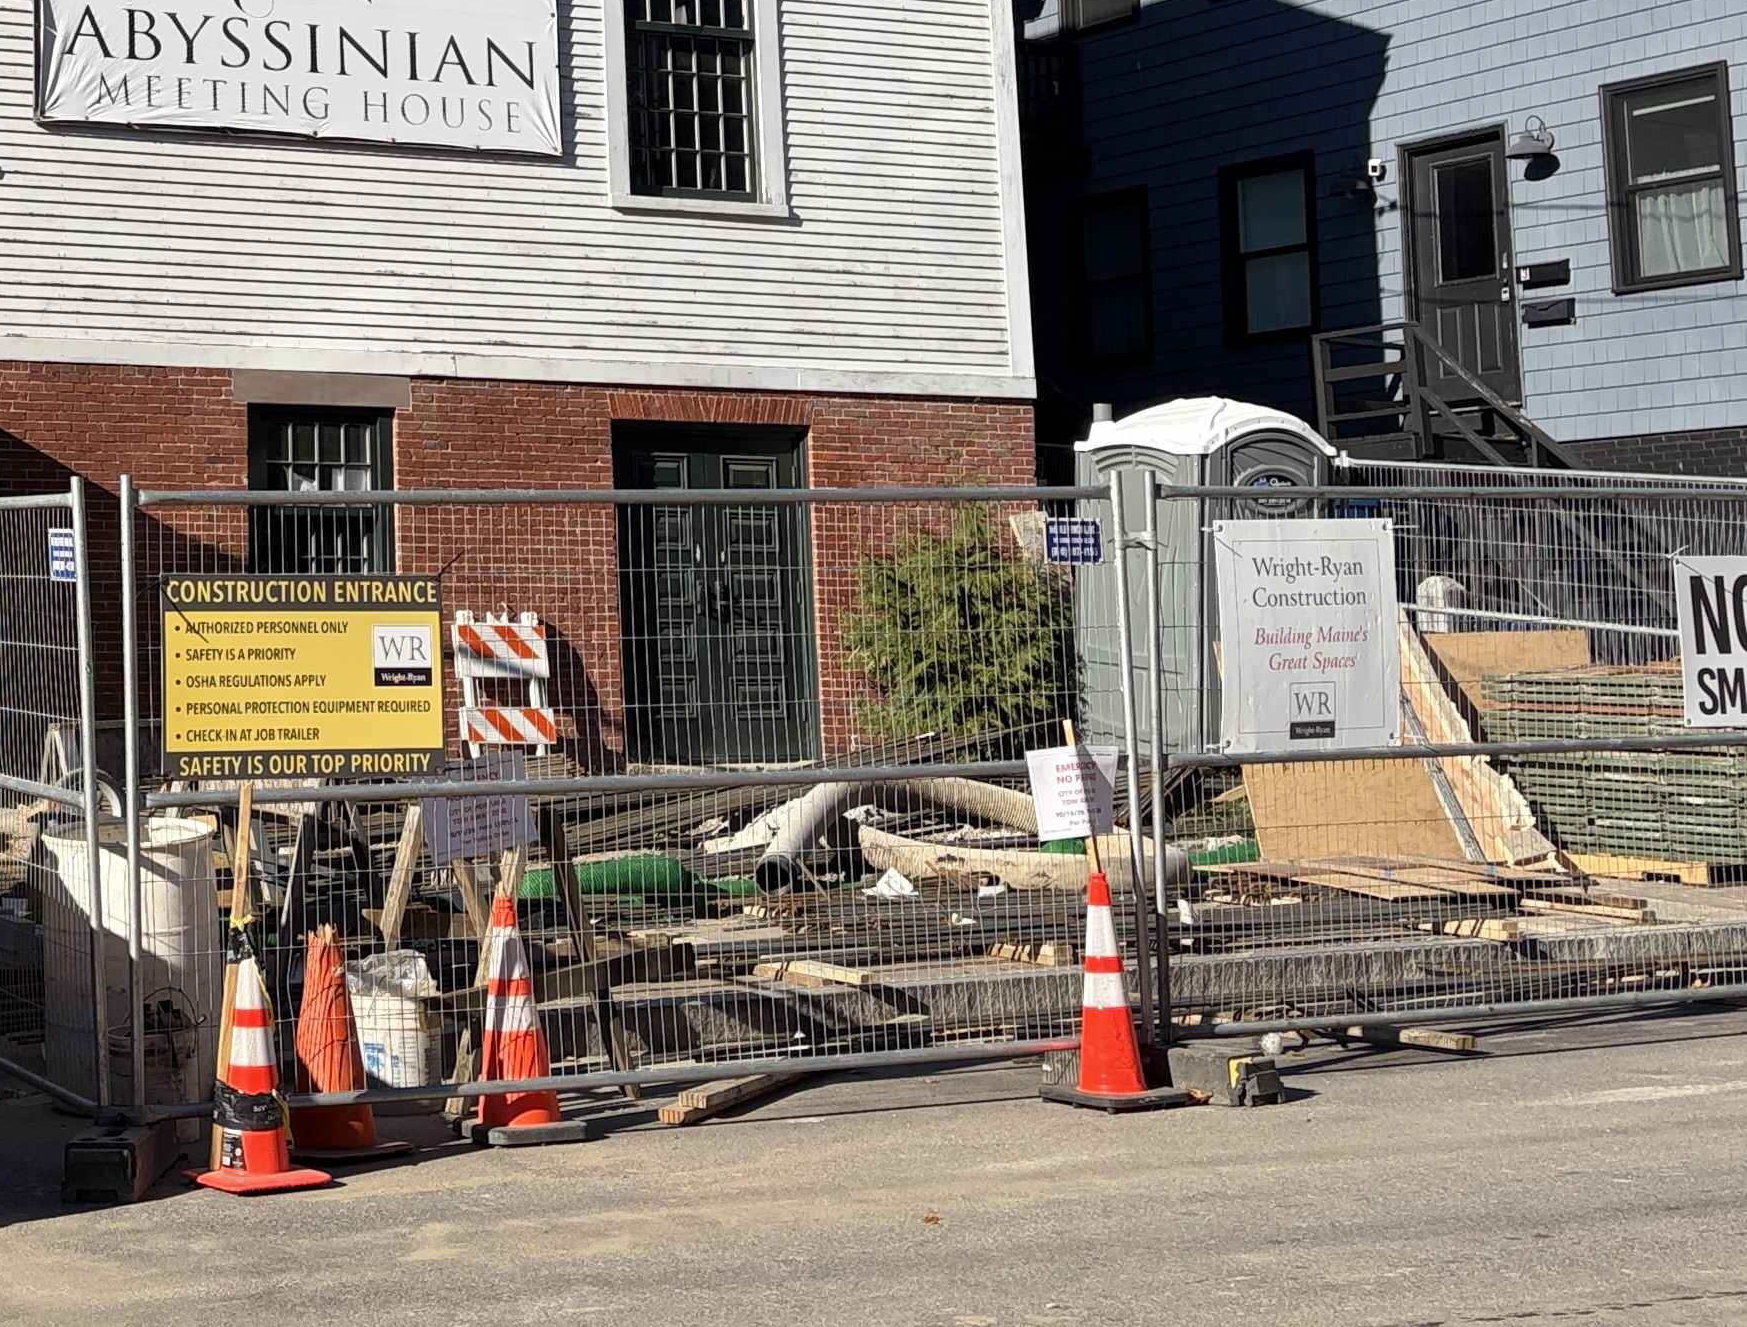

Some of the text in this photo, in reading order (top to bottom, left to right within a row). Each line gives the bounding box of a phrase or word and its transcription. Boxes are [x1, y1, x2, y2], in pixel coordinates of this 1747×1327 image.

[64, 4, 537, 90] ABYSSINIAN
[97, 72, 521, 134] MEETING HOUSE
[1252, 556, 1364, 584] Wright-Ryan
[167, 580, 437, 603] CONSTRUCTION ENTRANCE
[1252, 586, 1367, 608] Construction
[185, 621, 348, 634] AUTHORIZED PERSONNEL ONLY
[1254, 624, 1368, 649] Building Maine's
[186, 648, 296, 661] SAFETY IS A PRIORITY
[379, 635, 427, 662] WR
[1269, 651, 1358, 673] Great Spaces
[186, 674, 326, 688] OSHA REGULATIONS APPLY
[381, 673, 427, 684] Wright-Ryan
[186, 700, 431, 715] PERSONAL PROTECTION EQUIPMENT REQUIRED
[1293, 691, 1332, 716] WR
[186, 728, 320, 742] CHECK-IN AT JOB TRAILER
[179, 753, 431, 776] SAFETY IS OUR TOP PRIORITY
